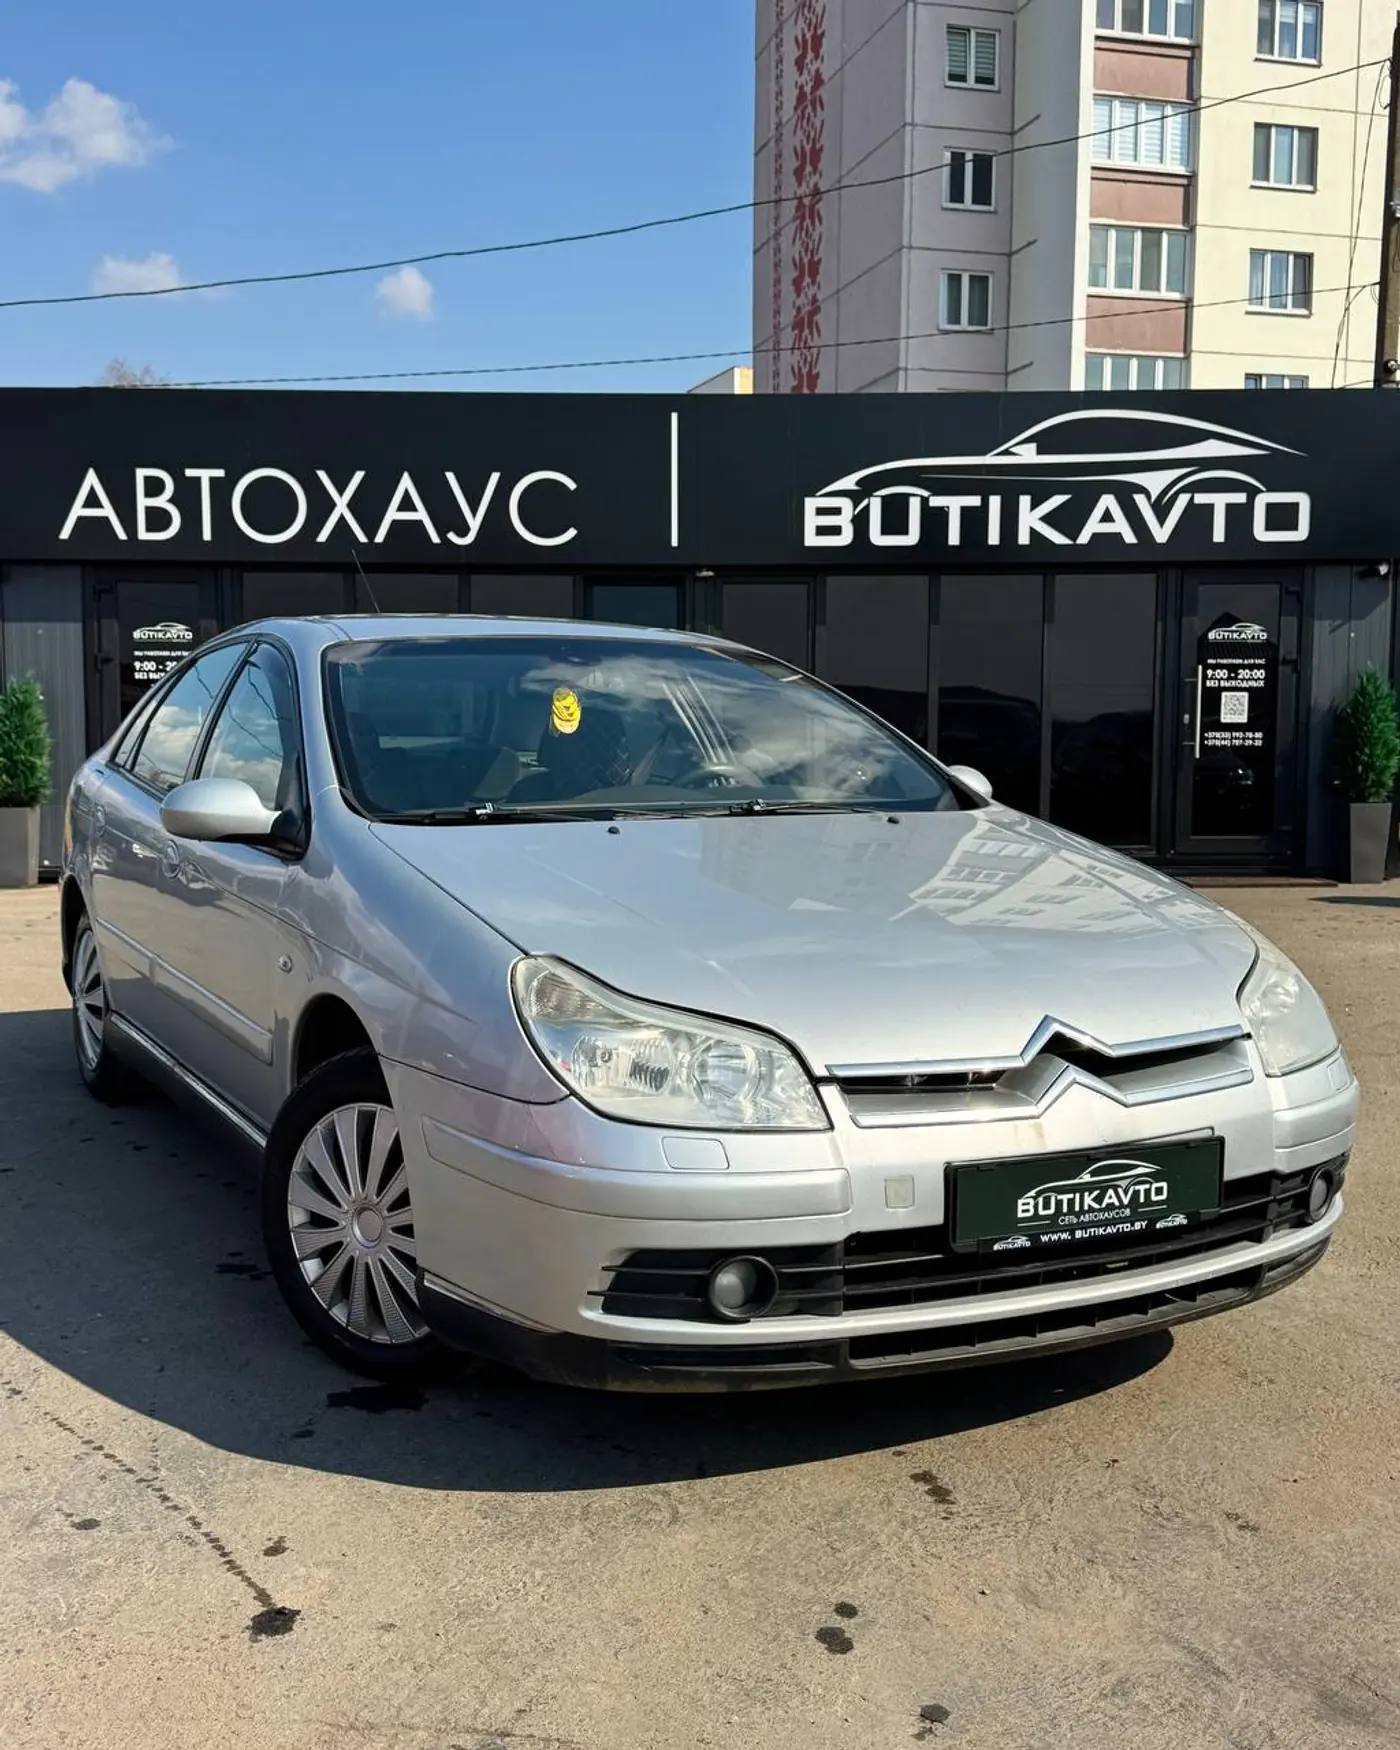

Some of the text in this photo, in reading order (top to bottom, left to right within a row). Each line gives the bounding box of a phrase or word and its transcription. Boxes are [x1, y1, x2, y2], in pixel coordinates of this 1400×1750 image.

[58, 467, 578, 545] АВТОХАУС
[804, 491, 1310, 547] BUTIKAVTO
[132, 631, 193, 639] BUTIKAVTO
[1208, 631, 1268, 640] BUTIKAVTO
[134, 661, 156, 671] 9:00
[1206, 669, 1228, 679] 9:00
[1237, 669, 1266, 679] 20:00
[1220, 680, 1265, 688] ВЫХОДНЫХ
[1017, 1181, 1168, 1218] BUTIKAVTO
[1058, 1208, 1131, 1225] СЕТЬ АВТОХАУСОВ
[993, 1240, 1031, 1251] BUTIKAVTO
